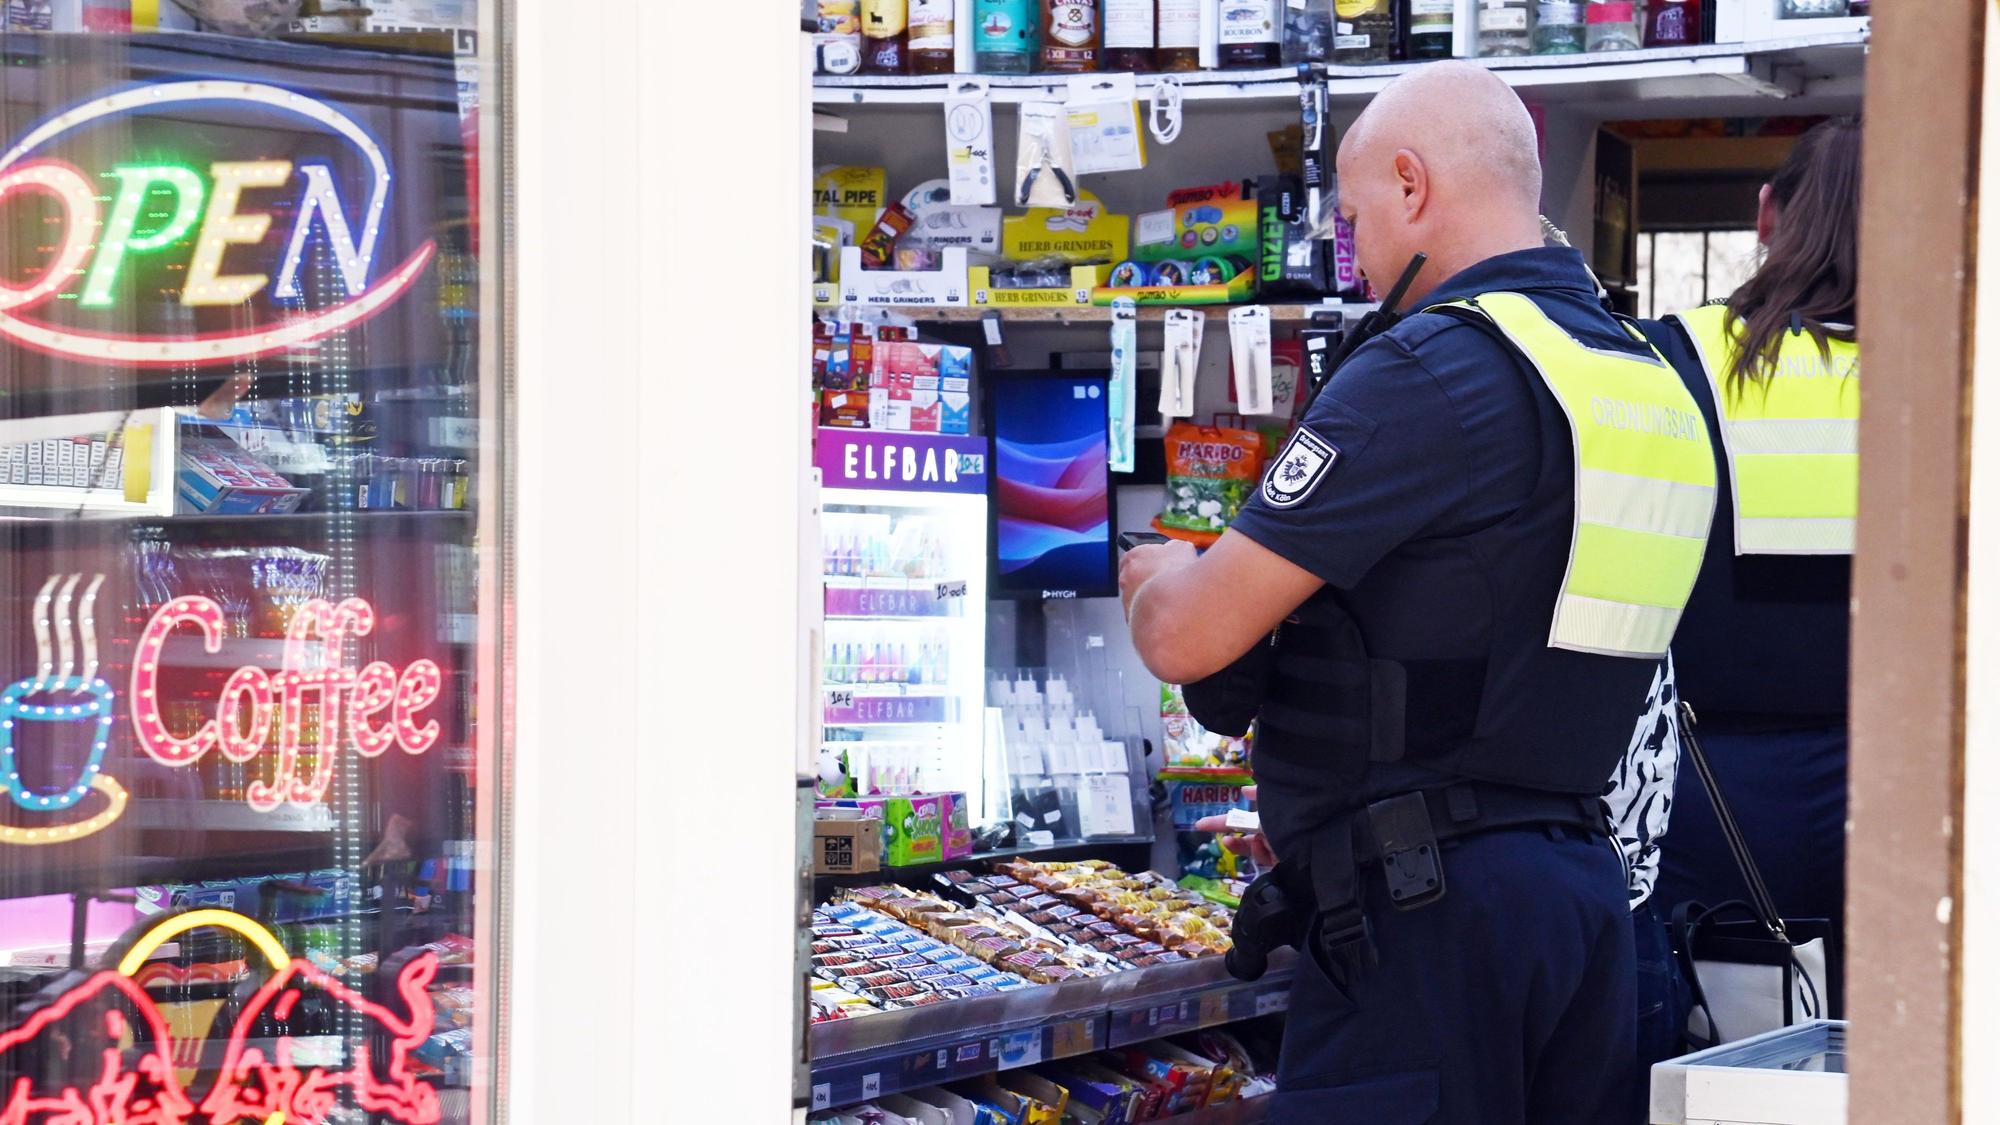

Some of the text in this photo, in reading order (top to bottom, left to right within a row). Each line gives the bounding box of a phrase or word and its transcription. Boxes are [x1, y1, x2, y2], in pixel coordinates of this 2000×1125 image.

[1083, 50, 1093, 59] 12
[844, 190, 877, 203] PIPE
[0, 160, 391, 312] OPEN
[1019, 239, 1113, 252] HERB GRINDERS
[868, 296, 936, 304] HERB GRINDERS
[977, 291, 985, 299] 12
[994, 292, 1019, 302] HERB
[1021, 291, 1068, 302] GRINDERS
[1077, 290, 1086, 298] 12
[1178, 441, 1243, 461] HARIBO
[844, 443, 958, 483] ELFBAR
[1051, 590, 1077, 598] HYGH
[860, 594, 917, 611] ELFBAR
[131, 595, 441, 812] Coffee
[858, 701, 914, 719] ELFBAR
[1182, 785, 1240, 803] HARIBO
